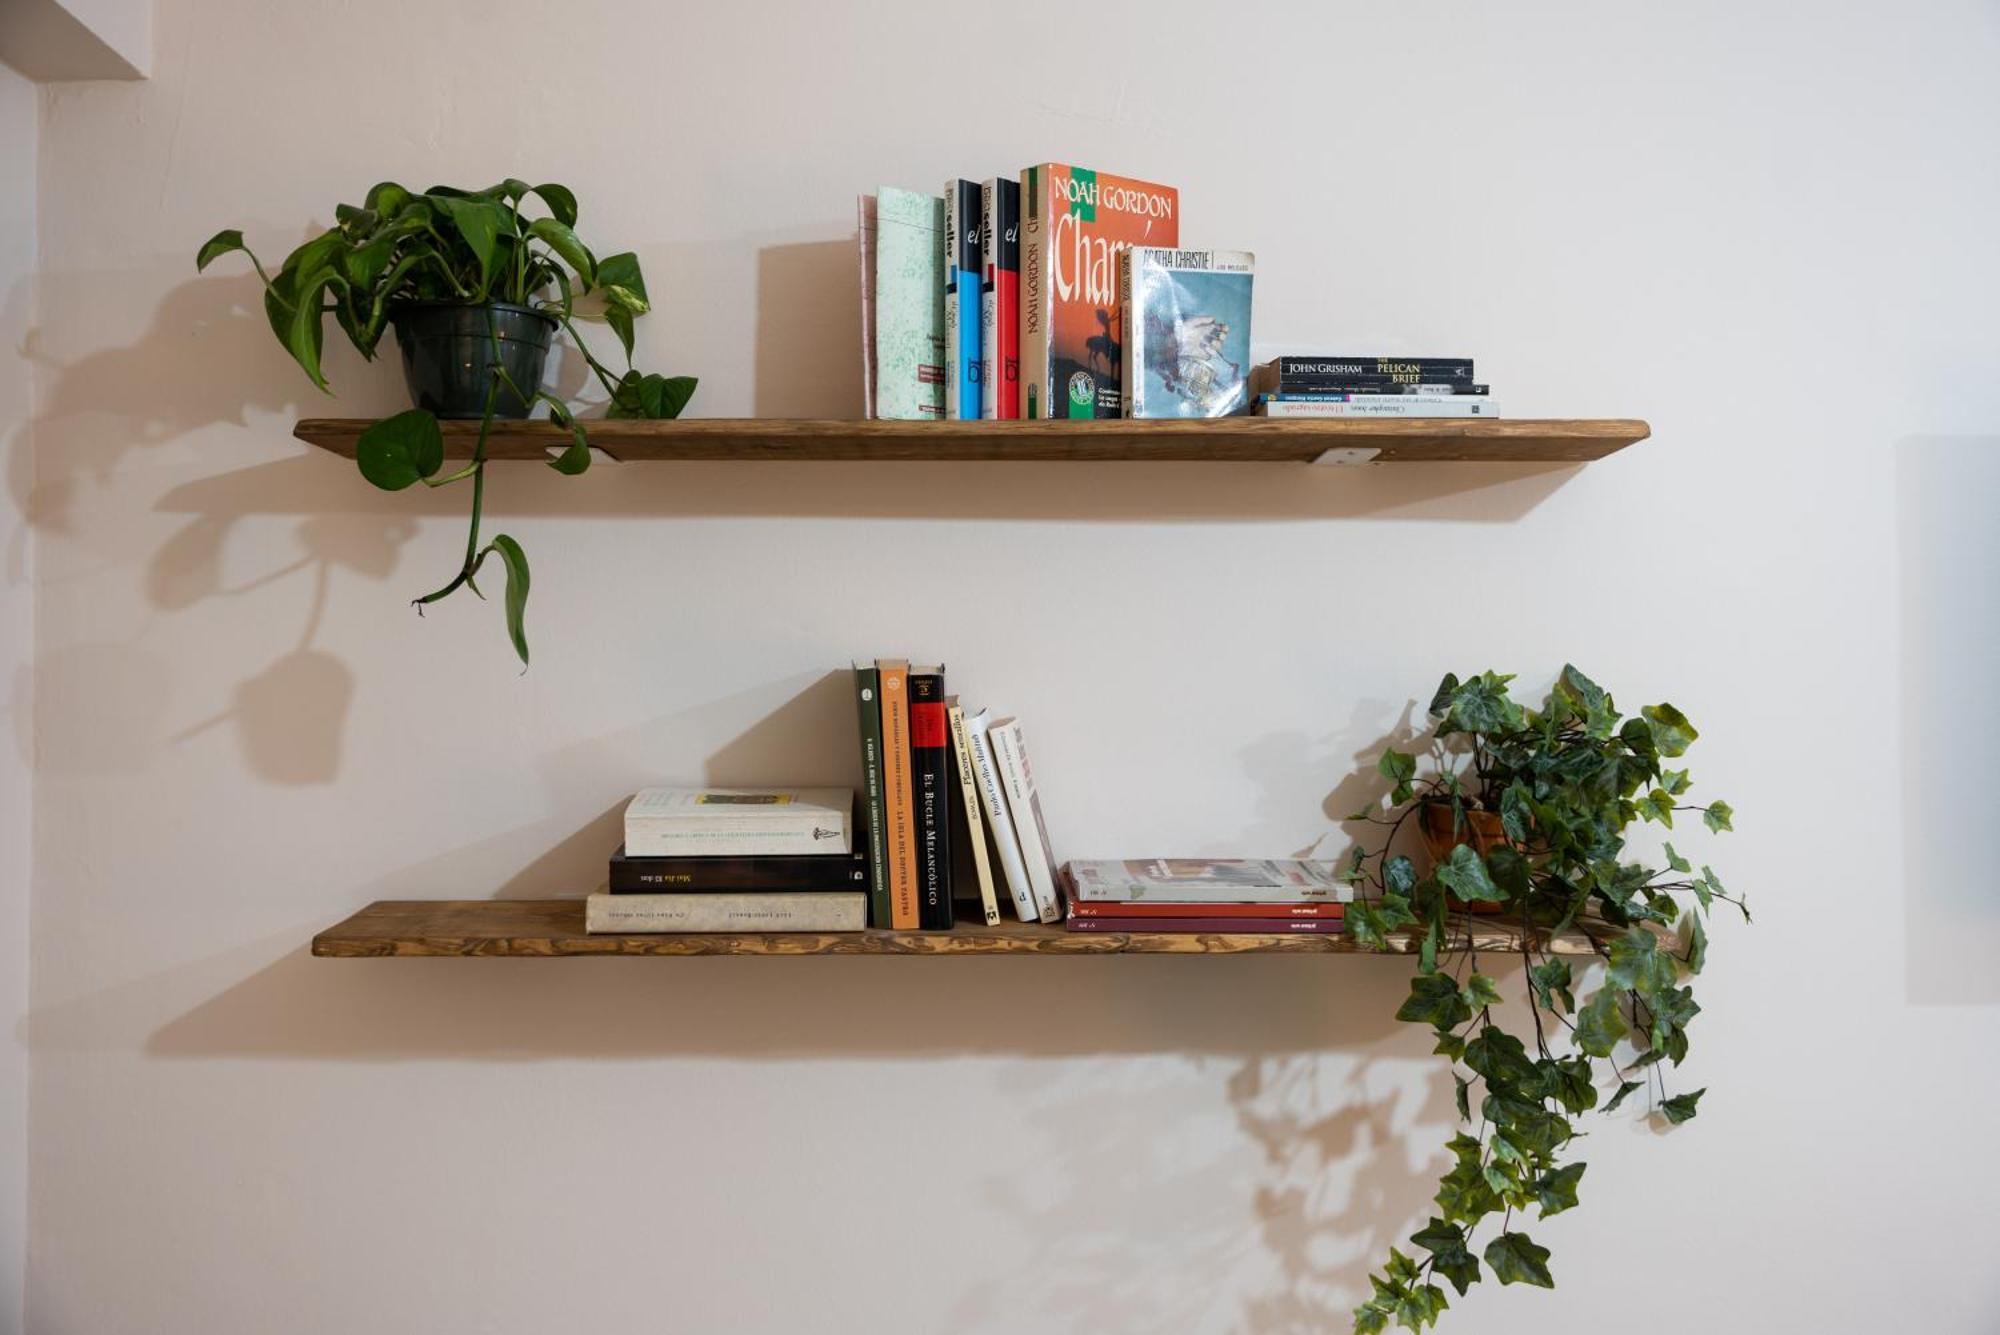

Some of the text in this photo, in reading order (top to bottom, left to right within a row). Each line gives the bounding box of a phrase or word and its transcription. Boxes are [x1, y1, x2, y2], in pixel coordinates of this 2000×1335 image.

[1055, 175, 1172, 219] NOAH GORDON
[1028, 243, 1038, 298] GORDON
[1175, 251, 1210, 270] CHRISTIE
[1028, 299, 1038, 334] NOAH
[1289, 363, 1362, 374] JOHN GRISHAM
[1377, 363, 1421, 374] PELICAN
[1392, 373, 1421, 384] BRIEF
[961, 750, 972, 785] Placeres
[924, 773, 938, 905] EL BUCLE MELANCÓLICO
